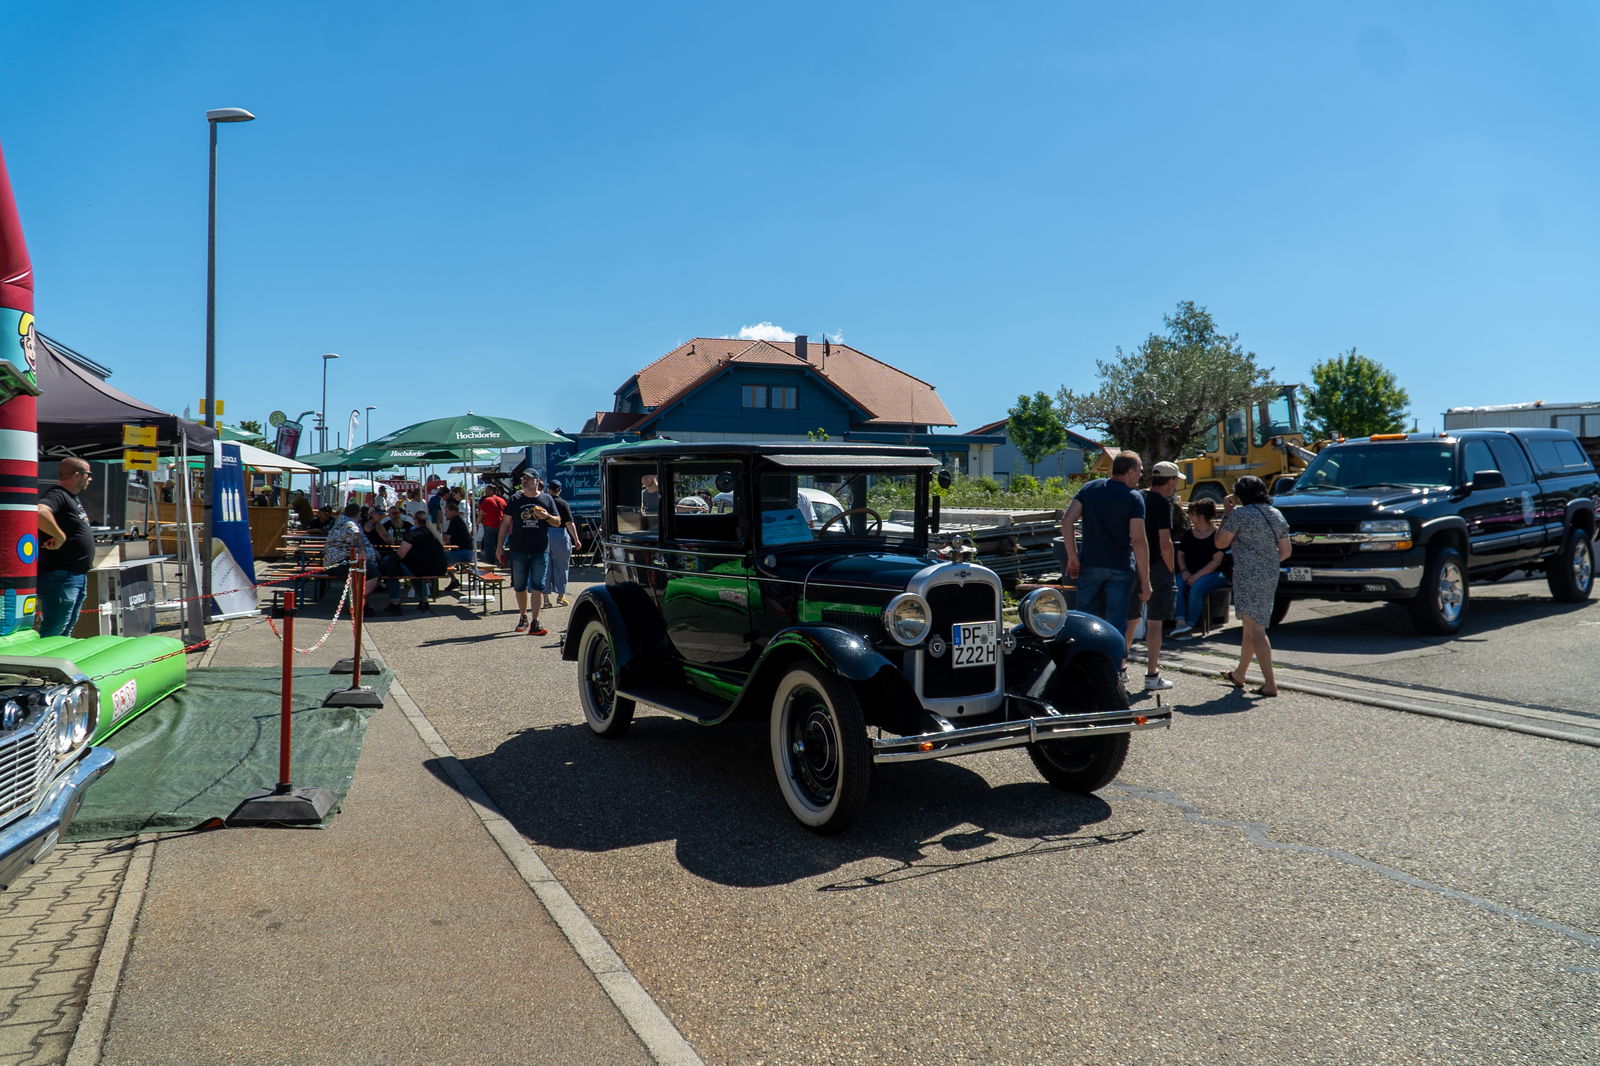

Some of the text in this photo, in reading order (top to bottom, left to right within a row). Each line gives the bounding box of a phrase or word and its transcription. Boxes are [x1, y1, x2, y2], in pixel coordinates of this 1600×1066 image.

[455, 431, 501, 440] Hochdorfer
[566, 477, 590, 488] Mark
[962, 627, 981, 645] PF
